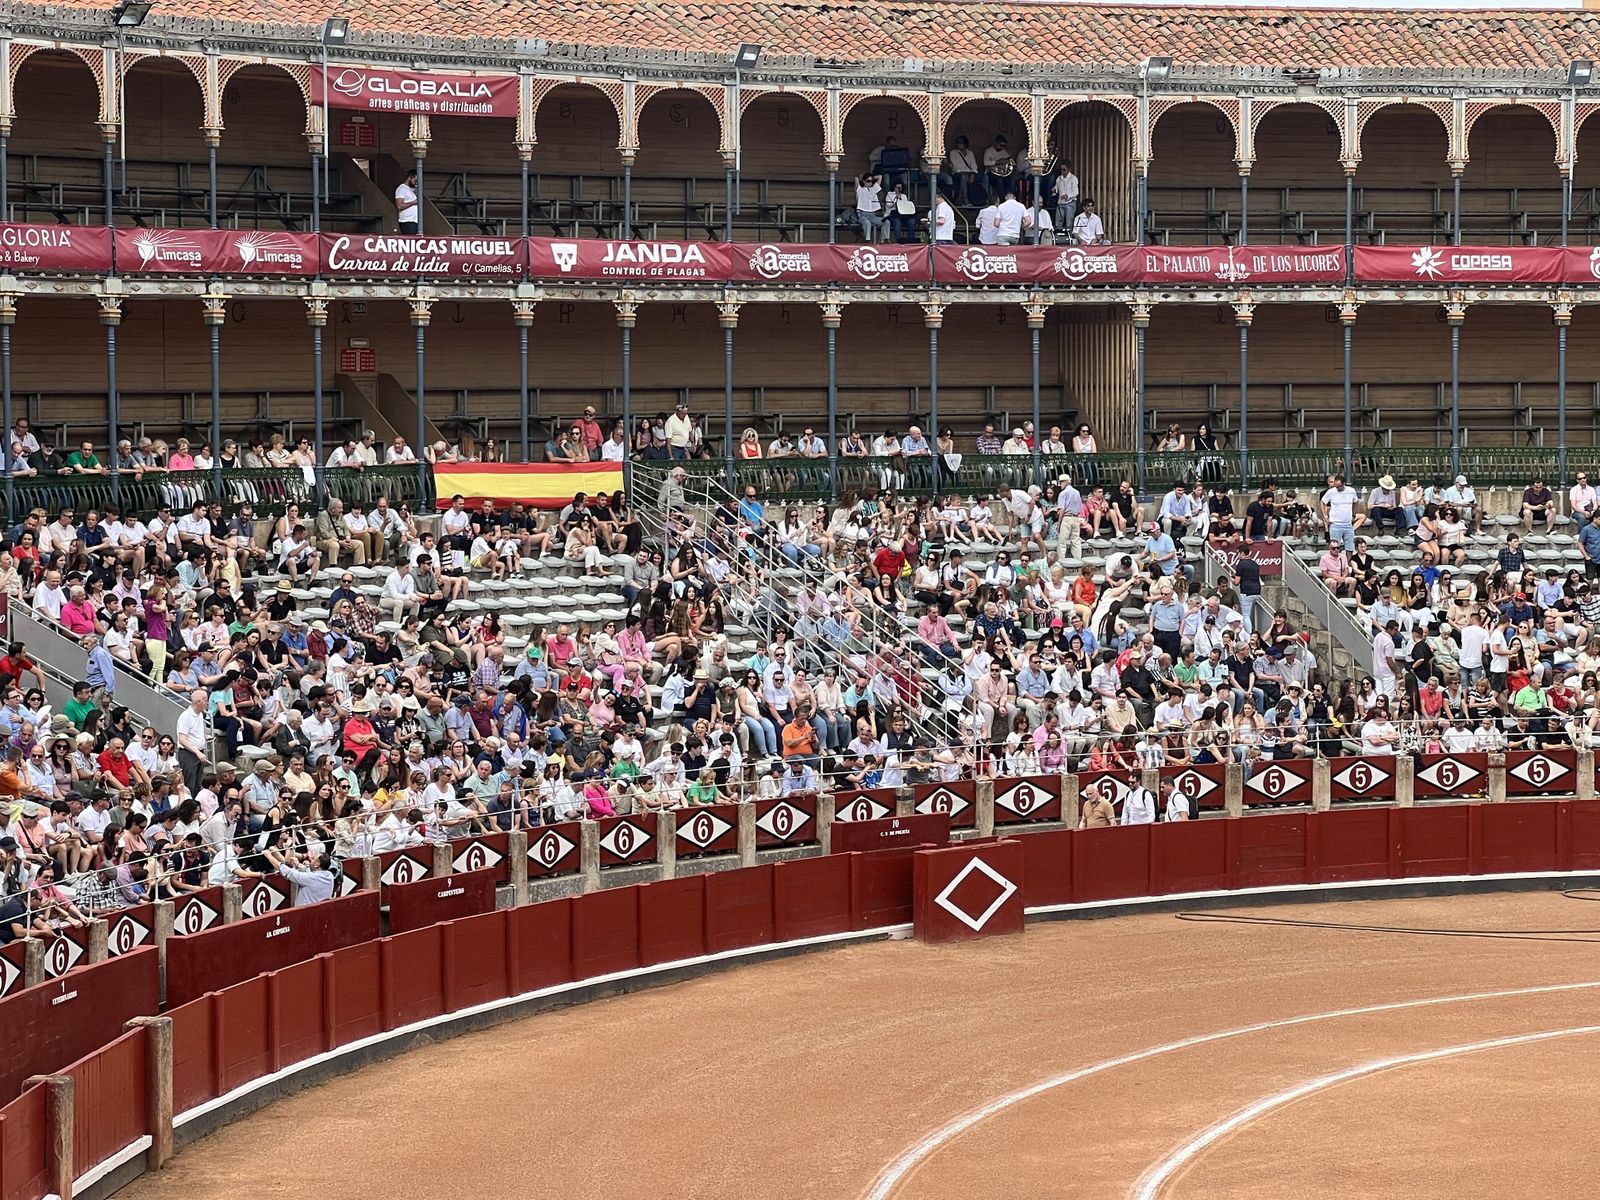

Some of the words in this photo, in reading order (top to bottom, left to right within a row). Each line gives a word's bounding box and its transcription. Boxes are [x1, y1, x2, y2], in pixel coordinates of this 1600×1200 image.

[368, 77, 492, 97] GLOBALIA
[369, 98, 391, 109] artes
[394, 100, 430, 112] gráficas
[433, 103, 438, 113] y
[440, 102, 493, 114] distribución
[155, 247, 202, 261] Limcasa
[328, 237, 387, 271] Carnes
[390, 256, 409, 272] de
[412, 256, 450, 273] lidia
[364, 236, 447, 254] CÁRNICAS
[451, 240, 515, 255] MIGUEL
[602, 243, 706, 264] JANDA
[4, 250, 12, 262] &
[14, 251, 40, 265] Bakery
[256, 249, 303, 263] Limcasa
[778, 252, 810, 260] comercial
[1146, 255, 1159, 272] EL
[1164, 256, 1210, 272] PALACIO
[1253, 256, 1268, 272] DE
[1272, 256, 1291, 271] LOS
[1295, 254, 1340, 271] LICORES
[1452, 255, 1512, 268] COPASA
[462, 264, 472, 273] C/
[516, 264, 522, 273] 5
[602, 267, 646, 276] CONTROL
[650, 268, 663, 276] DE
[667, 268, 705, 276] PLAGAS
[1356, 768, 1366, 787] 5
[1442, 765, 1454, 785] 5
[1533, 761, 1545, 782] 5
[1184, 777, 1195, 796] 5
[1269, 773, 1280, 793] 5
[1020, 788, 1030, 810] 5
[698, 820, 708, 840] 6
[776, 809, 788, 835] 6
[544, 838, 554, 860] 6
[618, 828, 628, 850] 6
[448, 878, 452, 888] 9
[257, 890, 266, 915] 6
[189, 906, 198, 932] 6
[121, 924, 130, 952] 6
[56, 944, 64, 972] 6
[61, 981, 65, 993] 1
